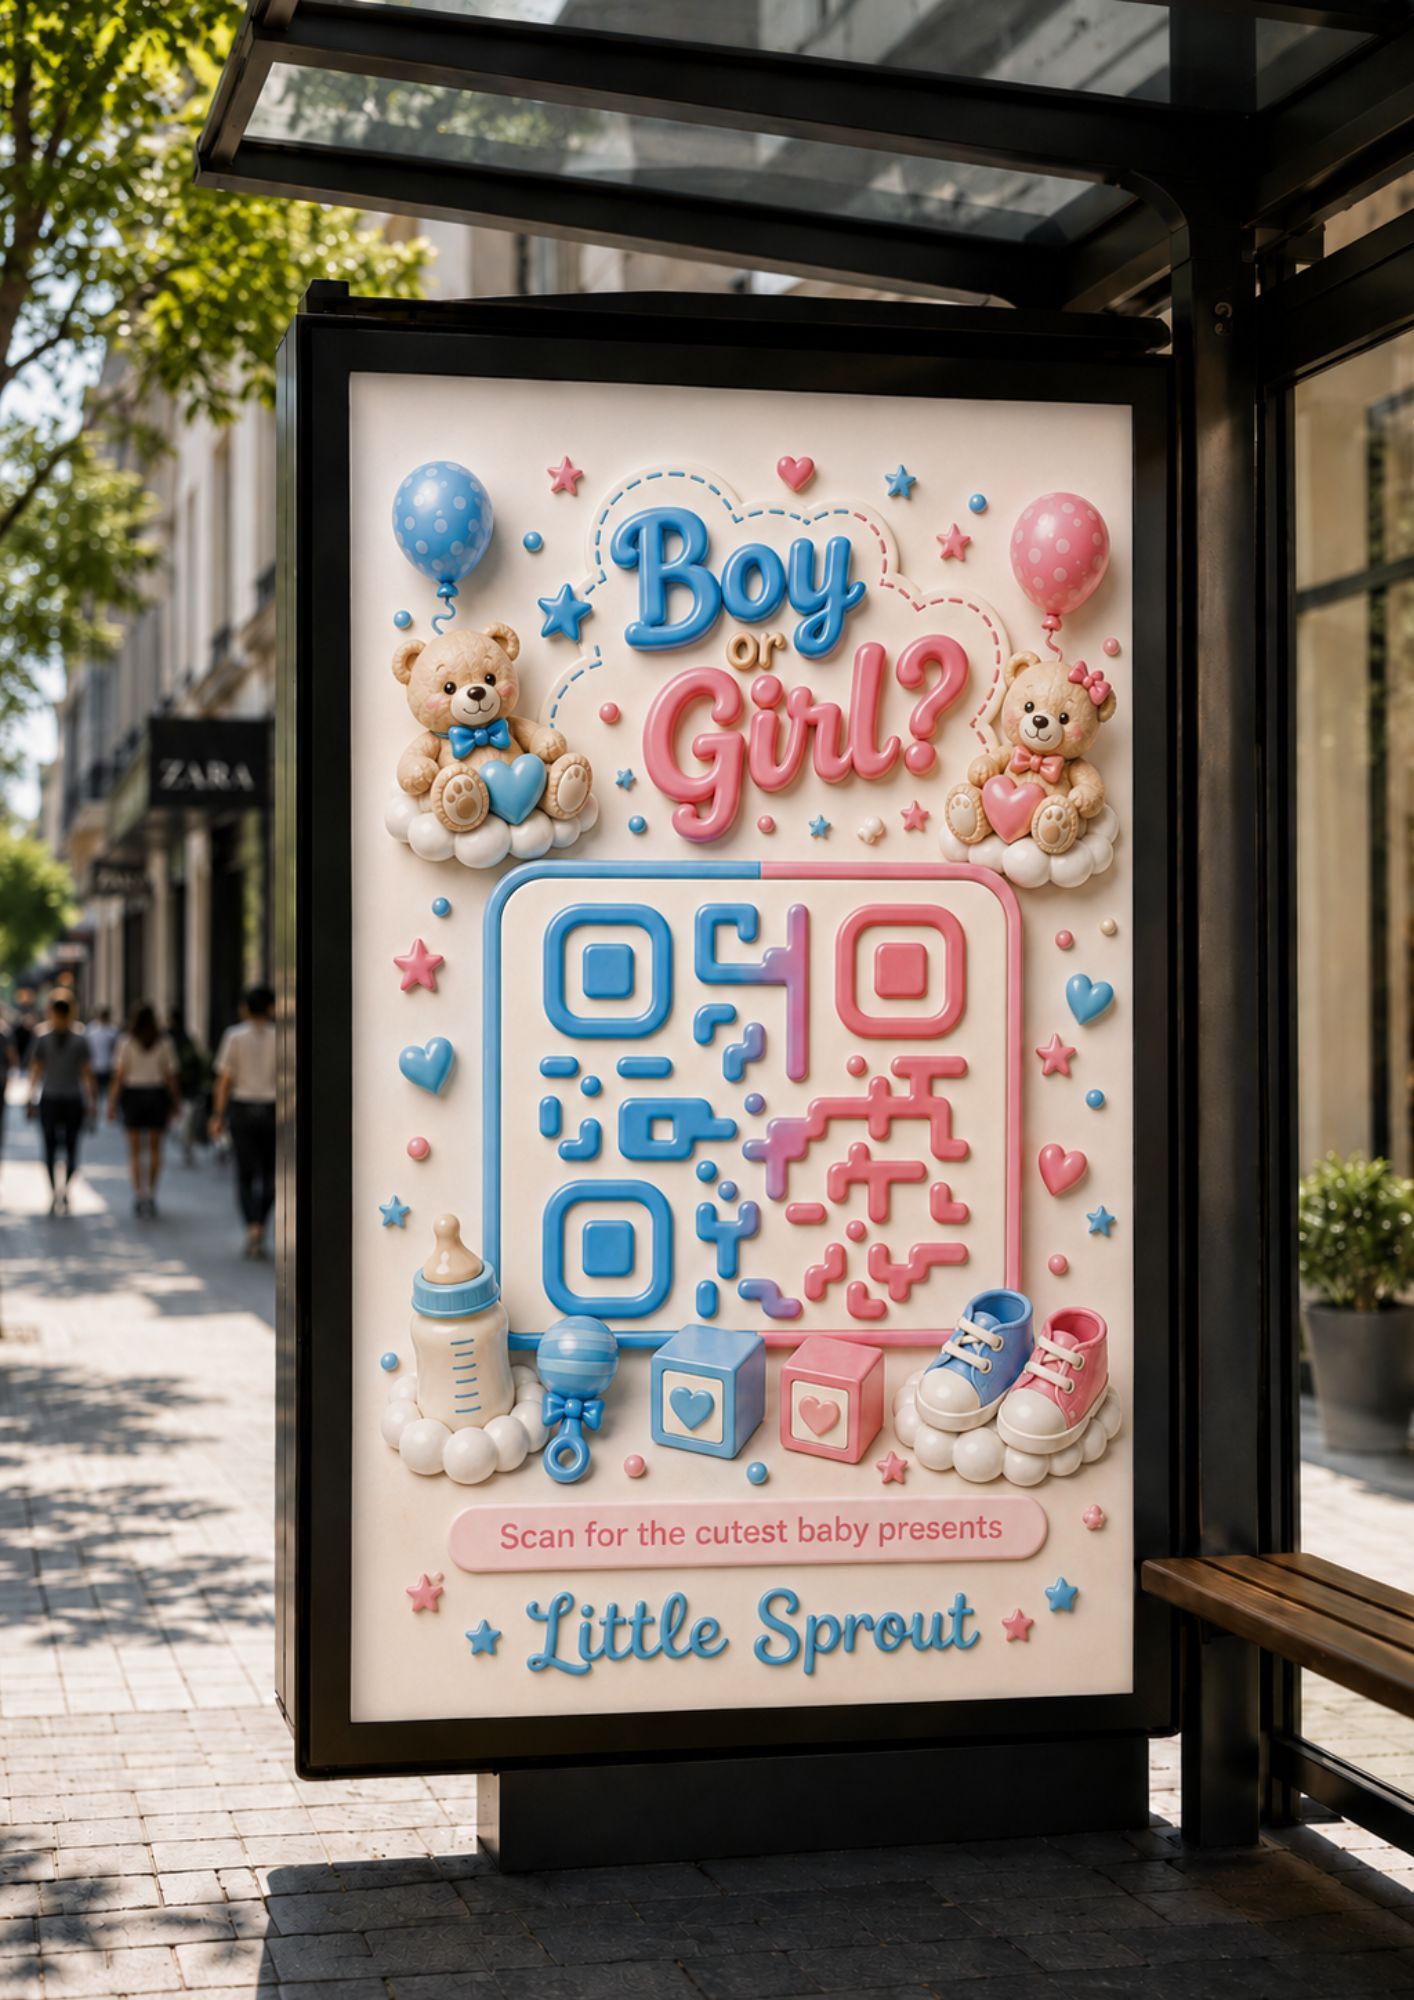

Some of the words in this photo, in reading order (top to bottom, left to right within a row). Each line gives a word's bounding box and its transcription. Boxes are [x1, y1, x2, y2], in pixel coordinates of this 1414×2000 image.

[610, 506, 867, 659] Boy
[726, 632, 786, 670] or
[642, 634, 970, 844] Girl?
[160, 758, 255, 792] ZARA
[500, 1522, 575, 1550] Scan
[584, 1520, 629, 1548] for
[636, 1519, 686, 1547] the
[694, 1519, 788, 1545] cutest
[797, 1515, 869, 1548] baby
[878, 1514, 1003, 1548] presents
[526, 1590, 730, 1676] Little
[753, 1586, 981, 1676] Sprout
